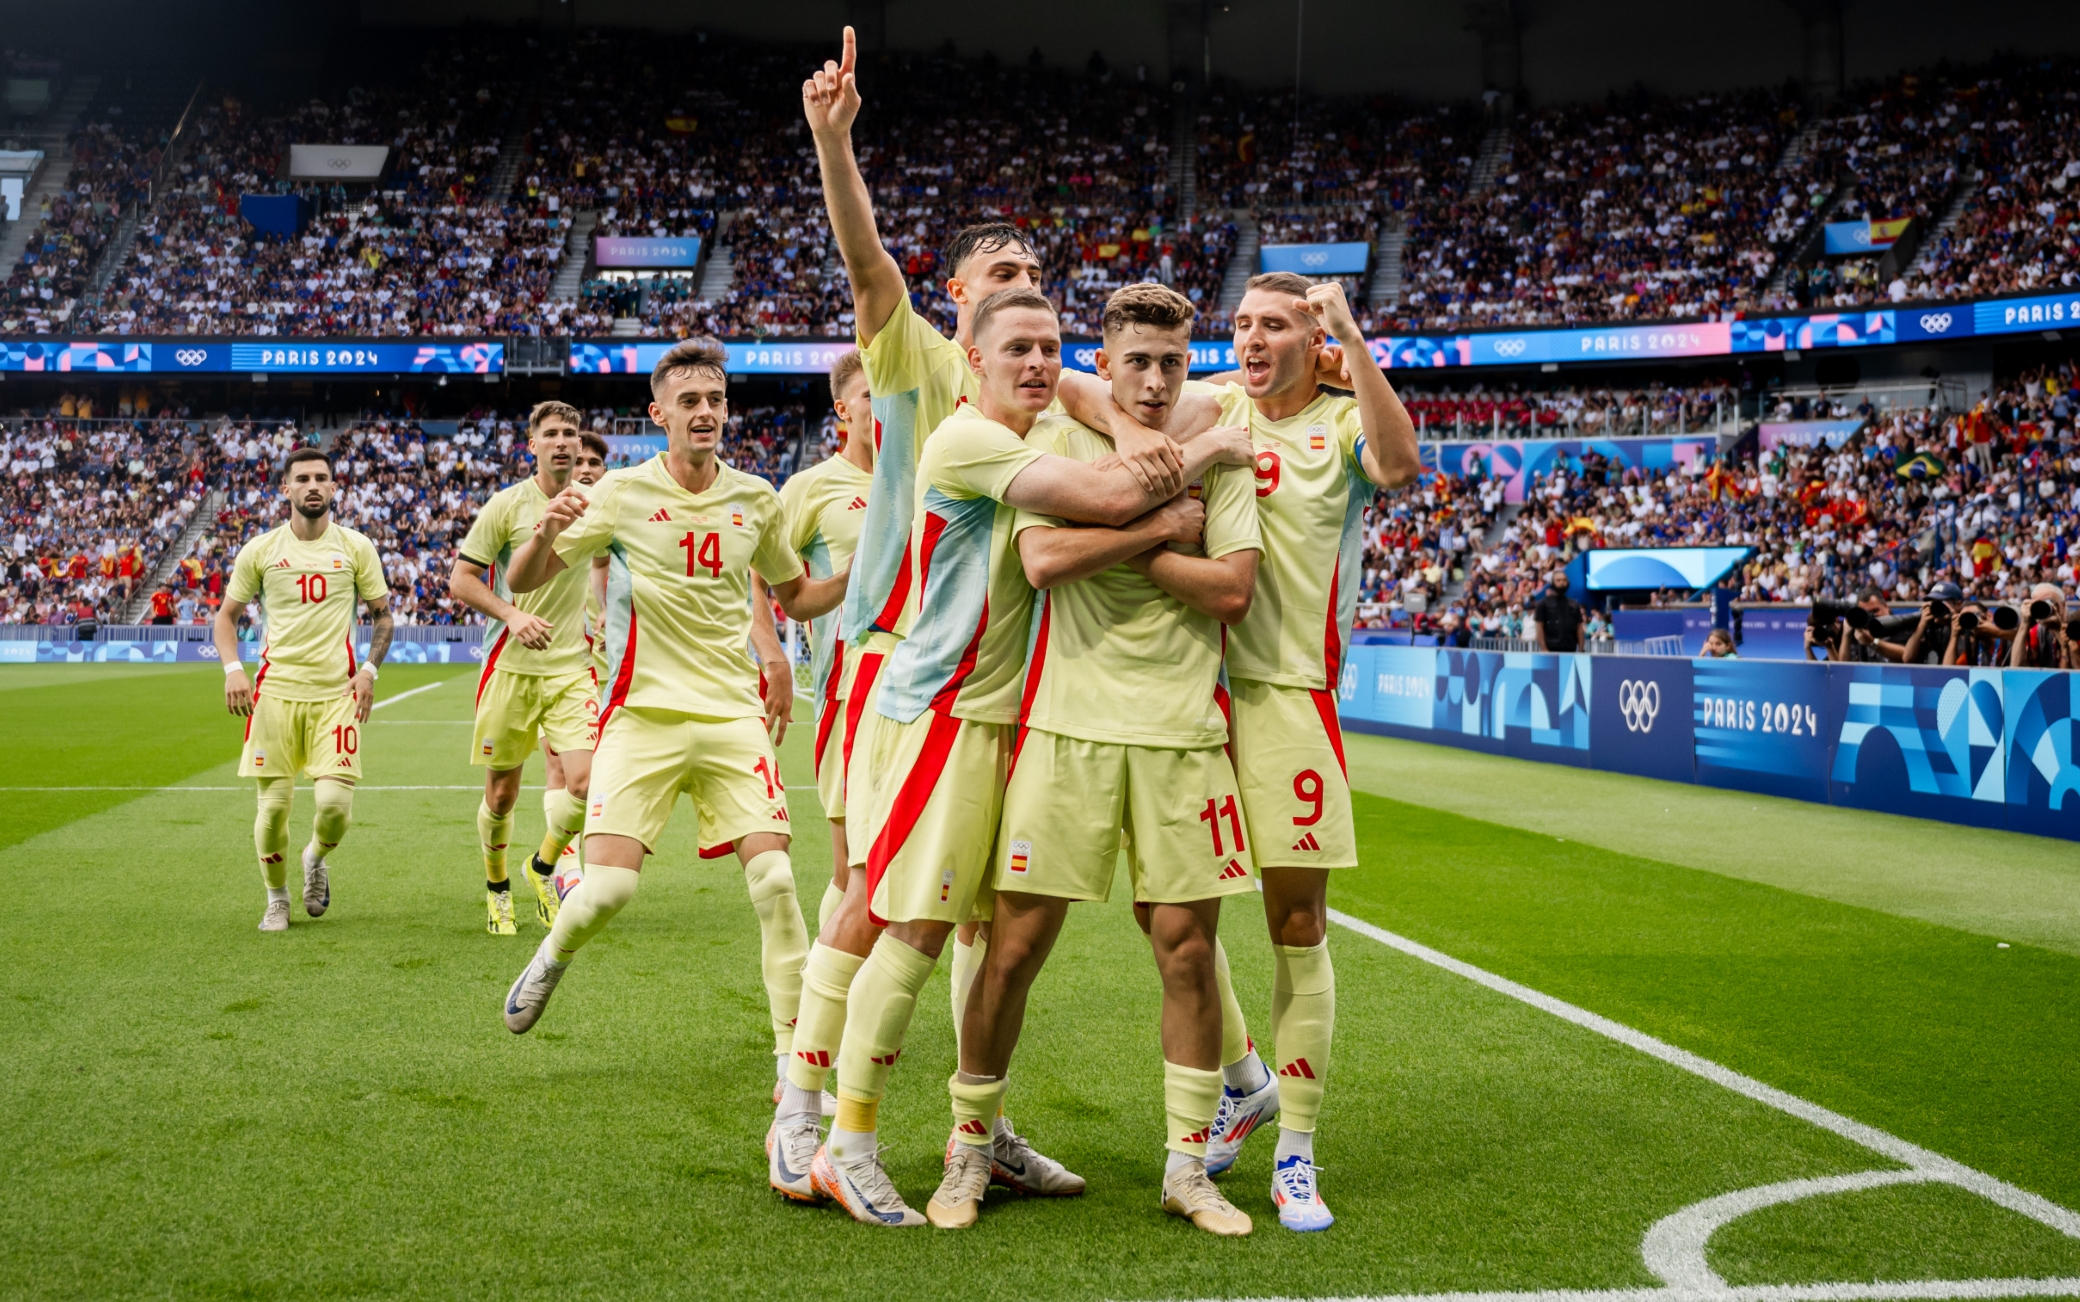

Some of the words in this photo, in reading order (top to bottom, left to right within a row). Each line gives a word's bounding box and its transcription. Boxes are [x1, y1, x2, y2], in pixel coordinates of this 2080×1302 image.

[611, 246, 648, 257] PARIS
[653, 246, 687, 257] 2024
[2005, 302, 2064, 325] PARIS
[262, 350, 320, 366] PARIS
[326, 350, 378, 366] 2024
[746, 350, 803, 366] PARIS
[1187, 348, 1220, 365] RIS
[1581, 334, 1641, 353] PARIS
[1648, 332, 1700, 350] 2024
[1254, 451, 1281, 498] 9
[679, 531, 724, 578] 14
[296, 573, 327, 604] 10
[1703, 697, 1755, 732] PARIS
[1761, 701, 1817, 737] 2024
[331, 724, 358, 755] 10
[1293, 768, 1324, 826] 9
[1200, 794, 1246, 858] 11
